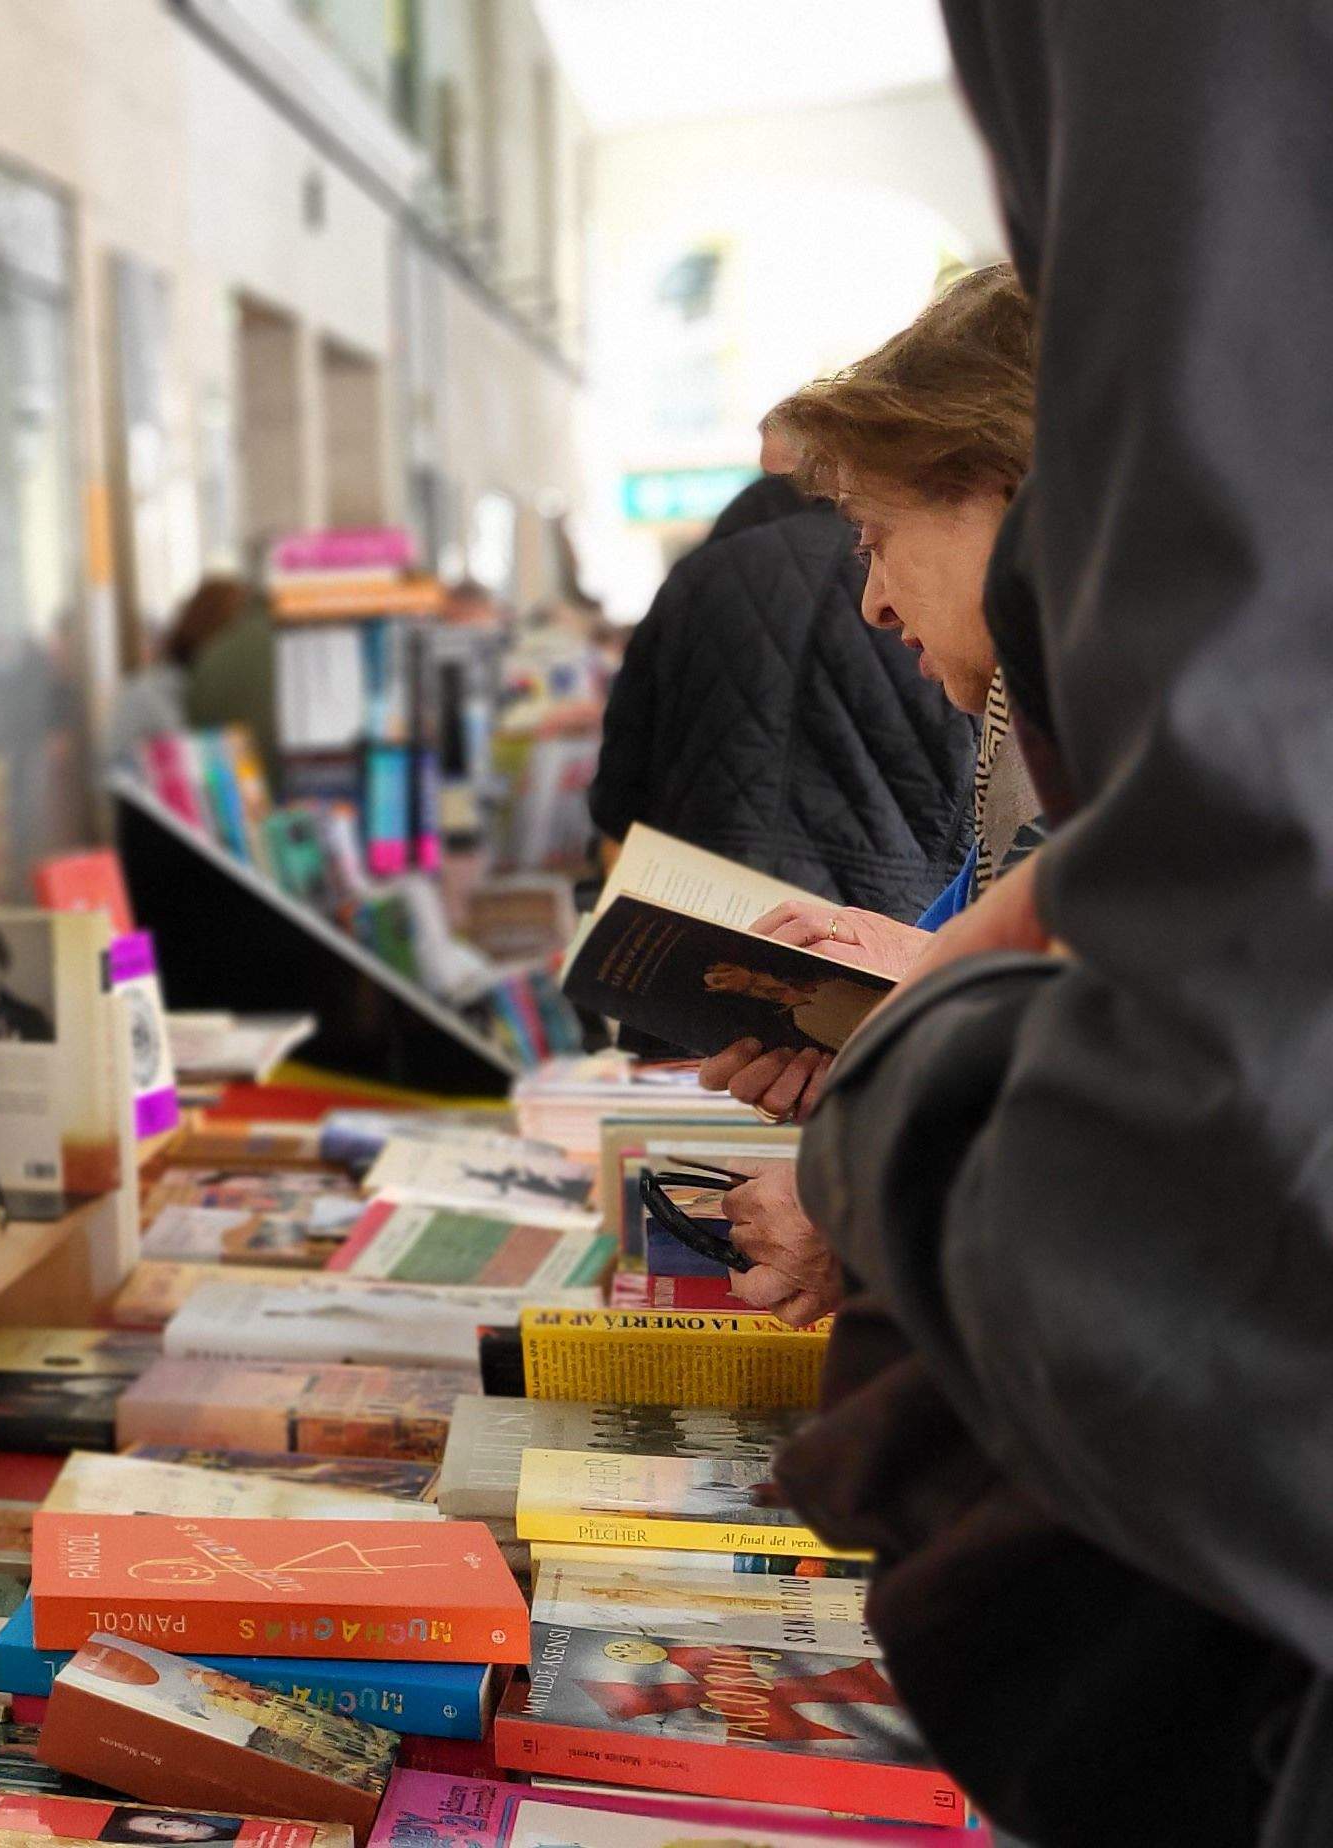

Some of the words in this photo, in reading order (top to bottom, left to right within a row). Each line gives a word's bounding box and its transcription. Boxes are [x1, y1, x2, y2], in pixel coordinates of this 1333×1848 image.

[604, 1314, 706, 1331] OMERTÁ
[713, 1318, 740, 1331] LA
[578, 1525, 648, 1542] PILCHER
[737, 1533, 765, 1547] final
[769, 1535, 786, 1546] del
[68, 1532, 101, 1580] PANCOL
[87, 1611, 186, 1634] PANCOL
[779, 1578, 816, 1645] SANATORIO
[238, 1616, 454, 1644] MUCHACHAS
[540, 1627, 572, 1669] ASENSI
[522, 1668, 560, 1716] MATILDE
